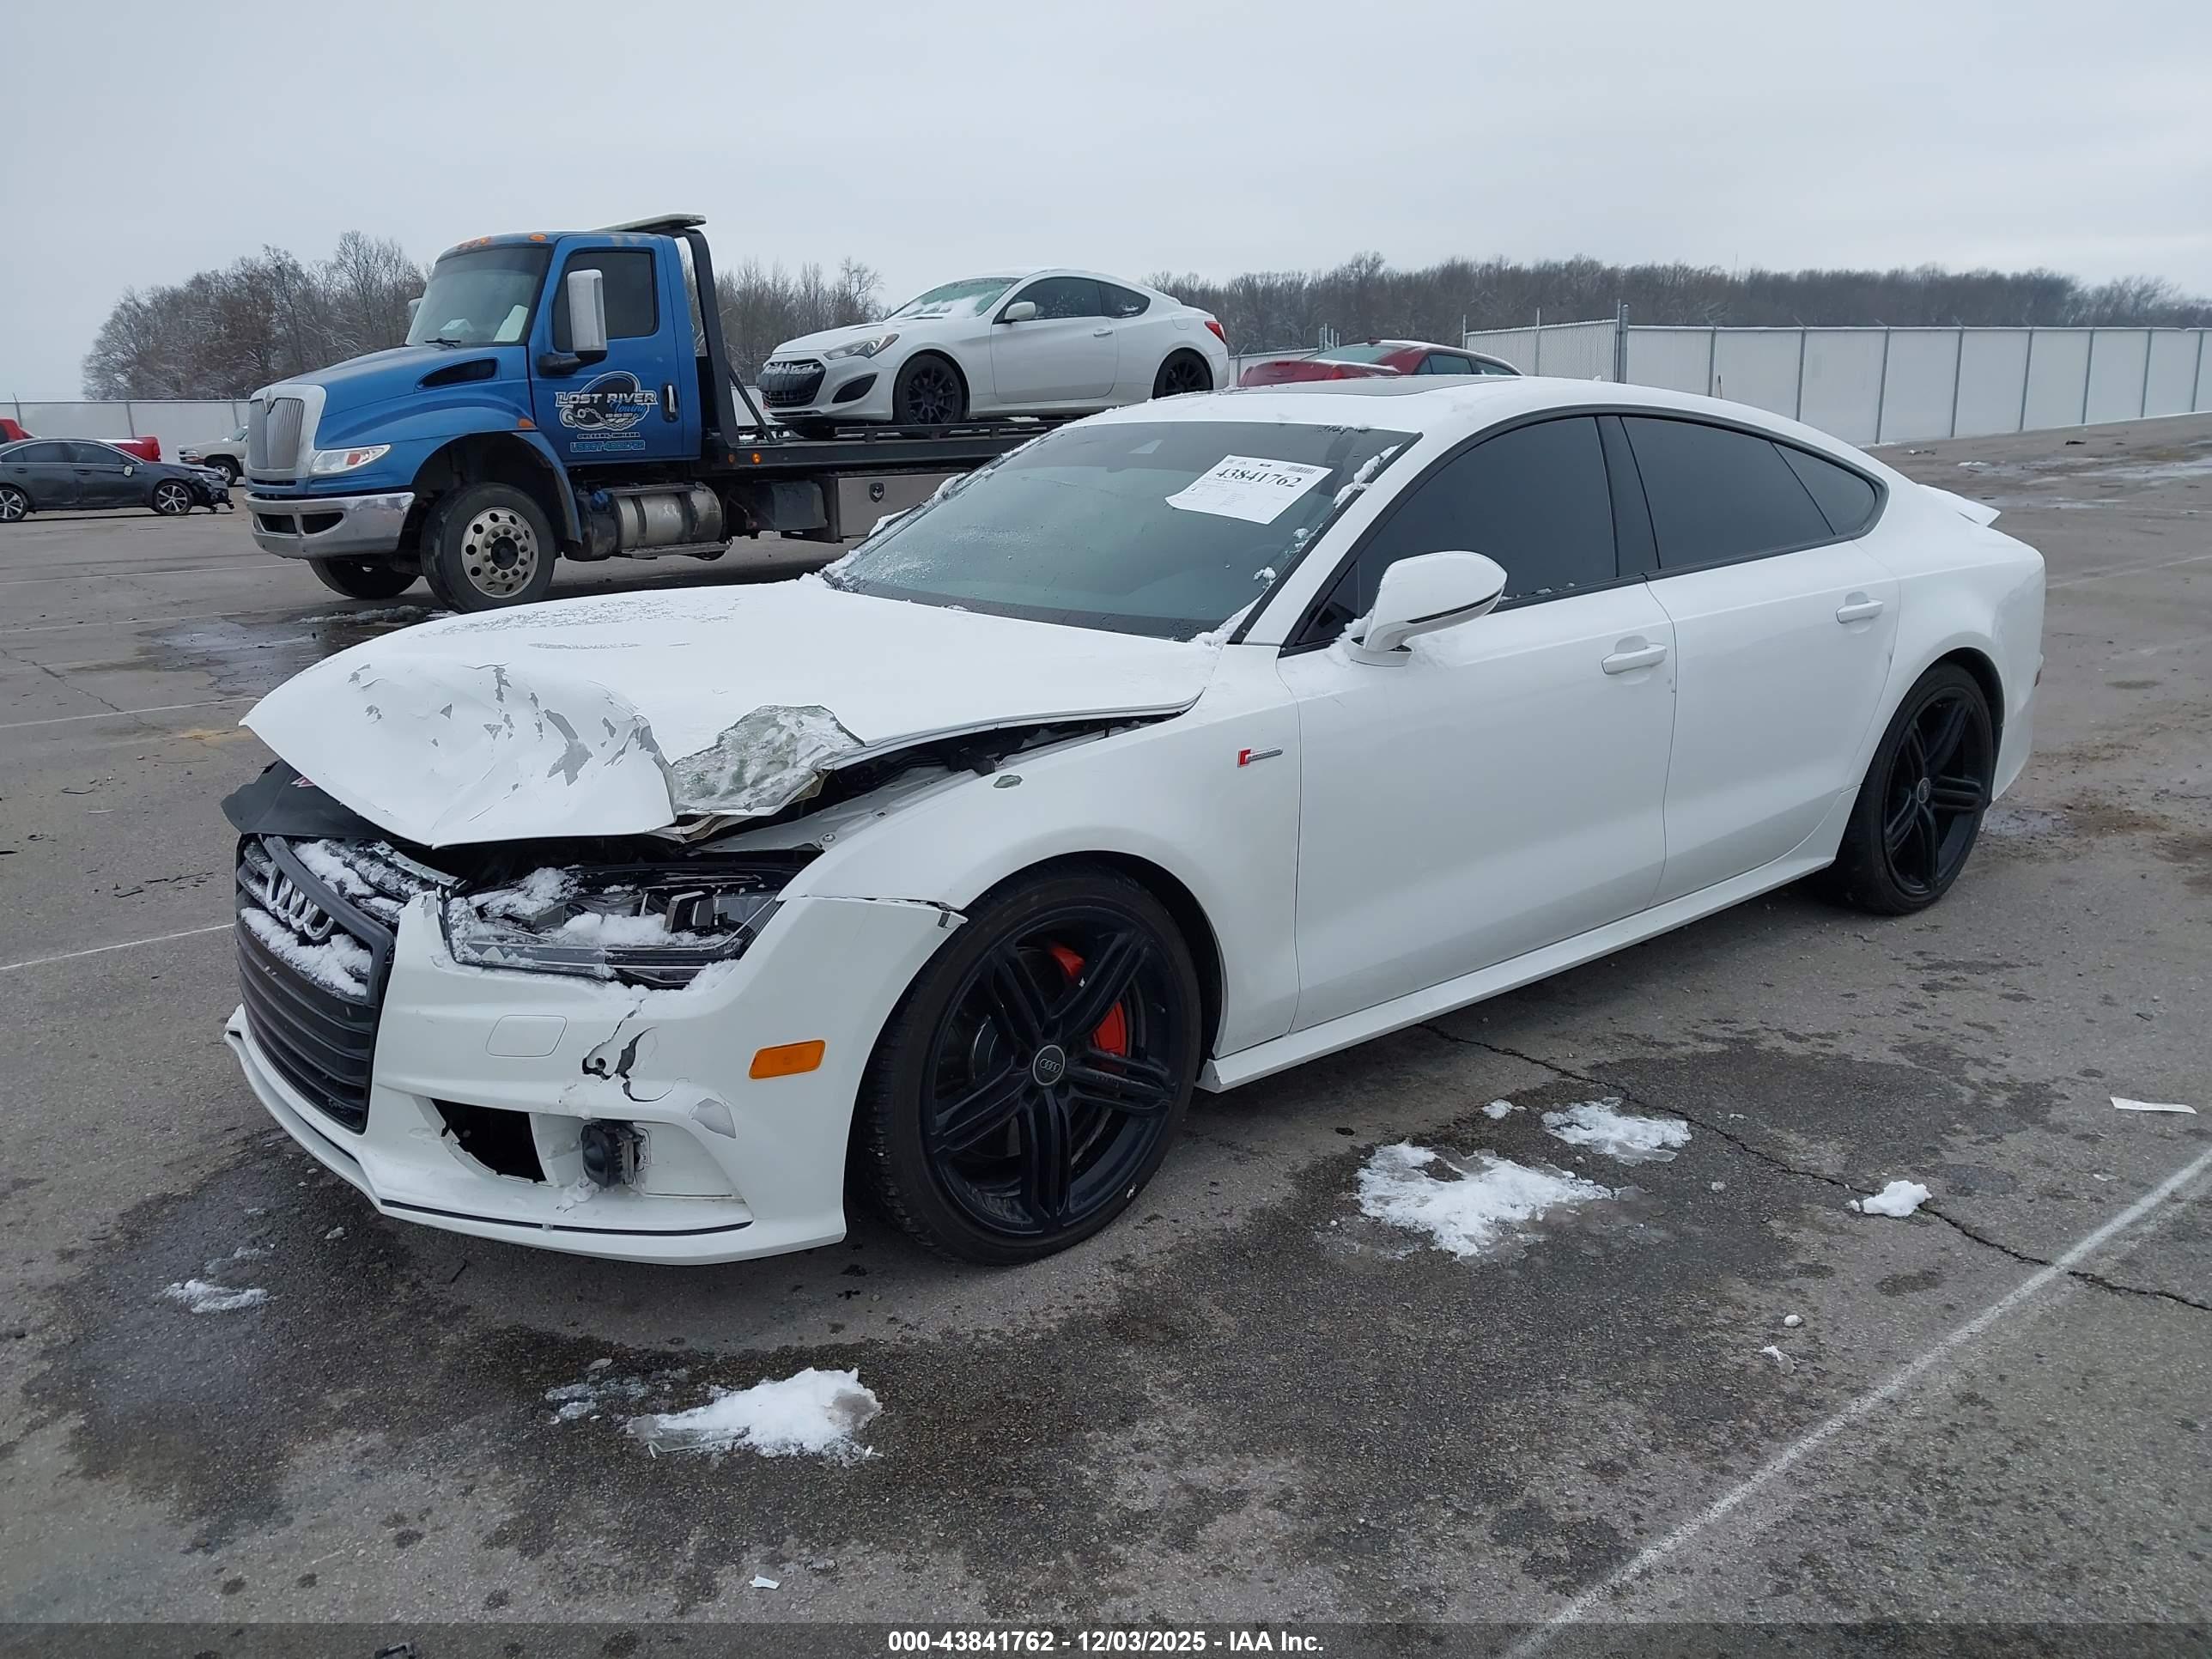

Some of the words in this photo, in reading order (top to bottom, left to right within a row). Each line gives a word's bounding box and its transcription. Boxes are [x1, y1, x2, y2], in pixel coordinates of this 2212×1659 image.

[558, 392, 602, 404] LOST
[606, 392, 654, 404] RIVER
[610, 399, 647, 416] Towing
[1216, 468, 1302, 488] 43841762
